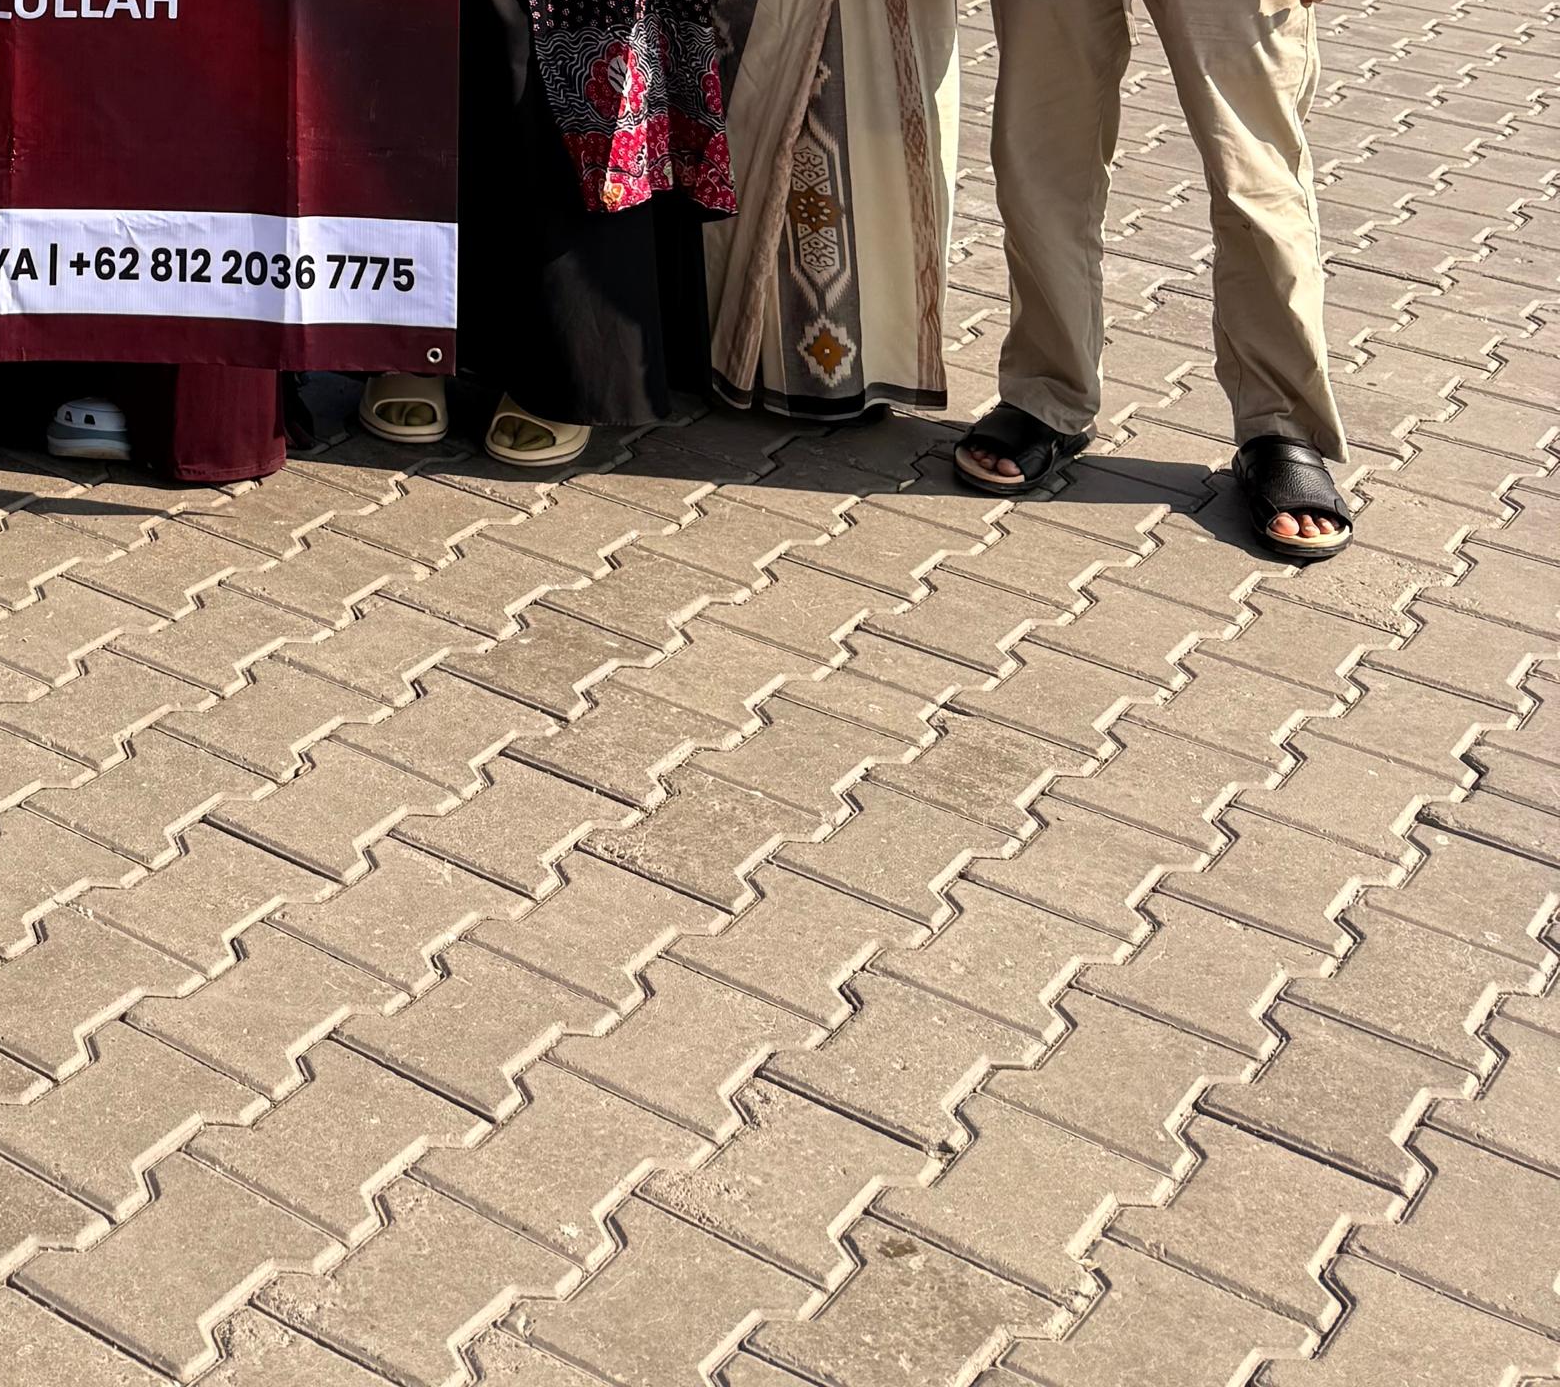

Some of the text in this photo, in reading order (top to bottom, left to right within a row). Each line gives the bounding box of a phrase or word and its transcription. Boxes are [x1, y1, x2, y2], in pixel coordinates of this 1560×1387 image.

[70, 247, 139, 280] +62
[151, 248, 211, 282] 812
[222, 250, 315, 289] 2036
[327, 255, 414, 292] 7775
